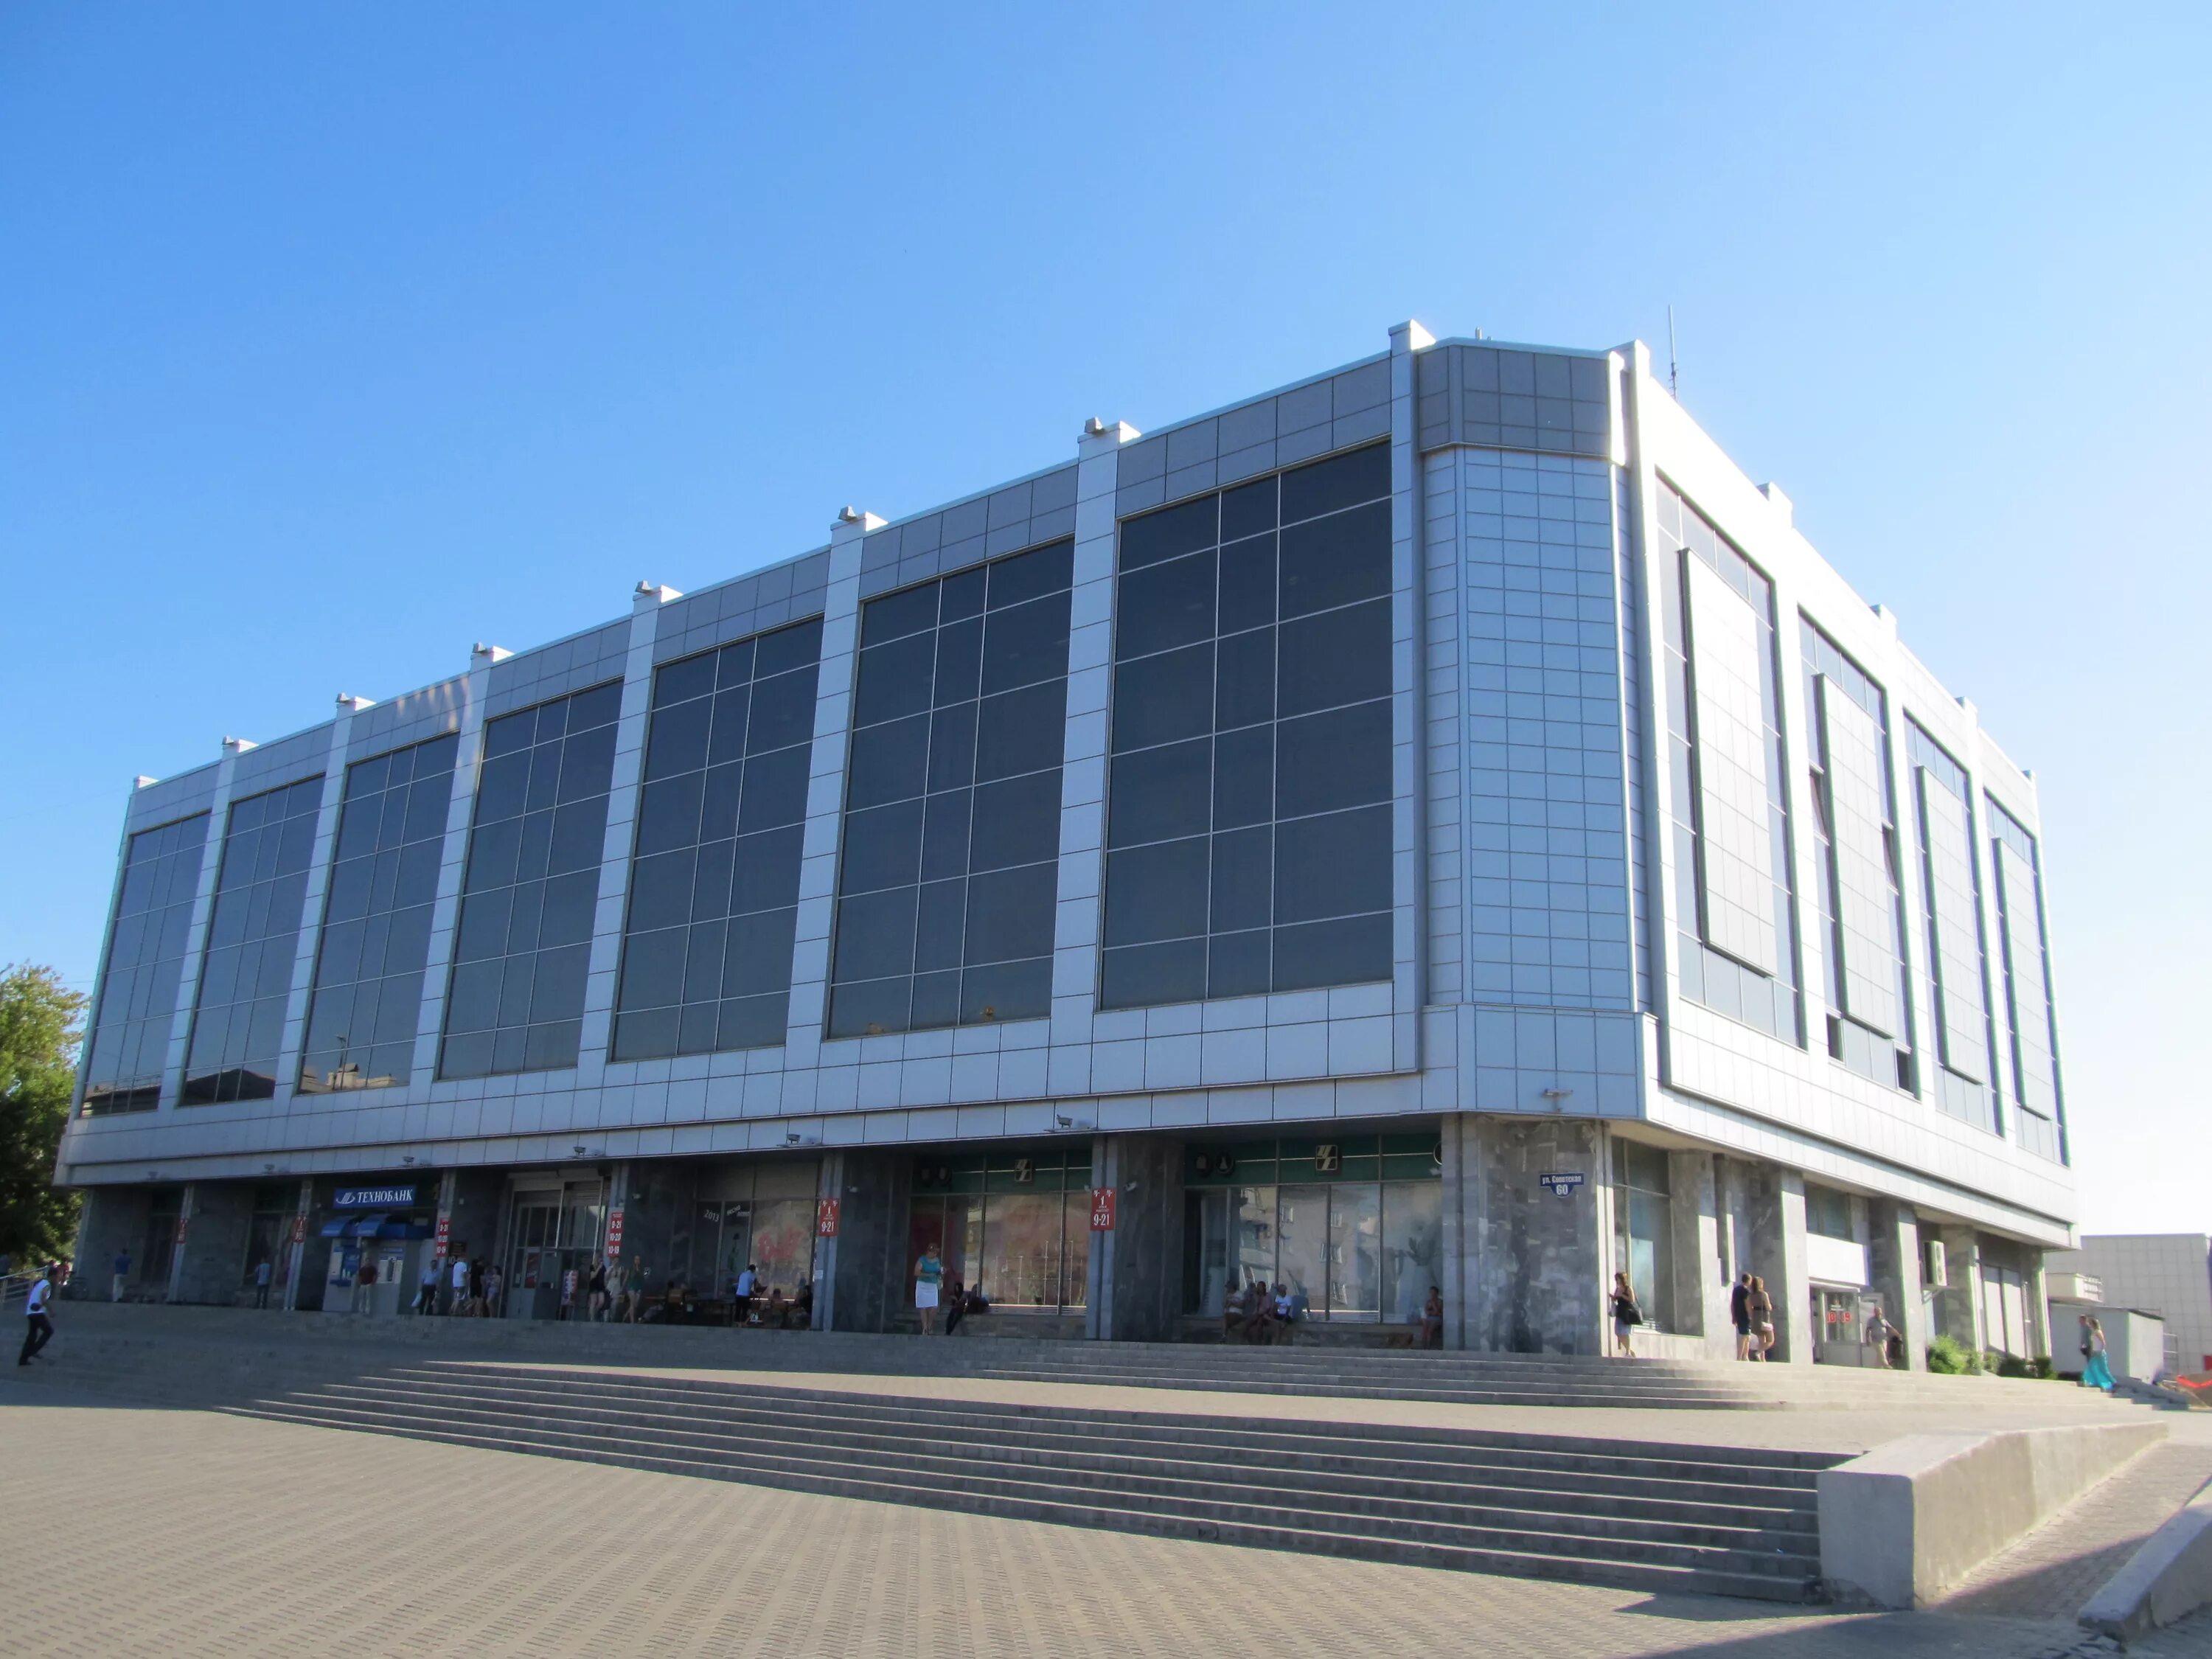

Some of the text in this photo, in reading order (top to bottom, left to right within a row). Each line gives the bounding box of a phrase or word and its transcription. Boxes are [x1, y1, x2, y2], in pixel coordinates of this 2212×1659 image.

[1542, 1177, 1551, 1185] ул.
[1557, 1184, 1568, 1195] 60
[358, 1189, 413, 1203] ТЕХНОБАНК
[704, 1209, 720, 1222] 2013
[1093, 1214, 1110, 1226] 9-21
[821, 1221, 835, 1233] 9-21
